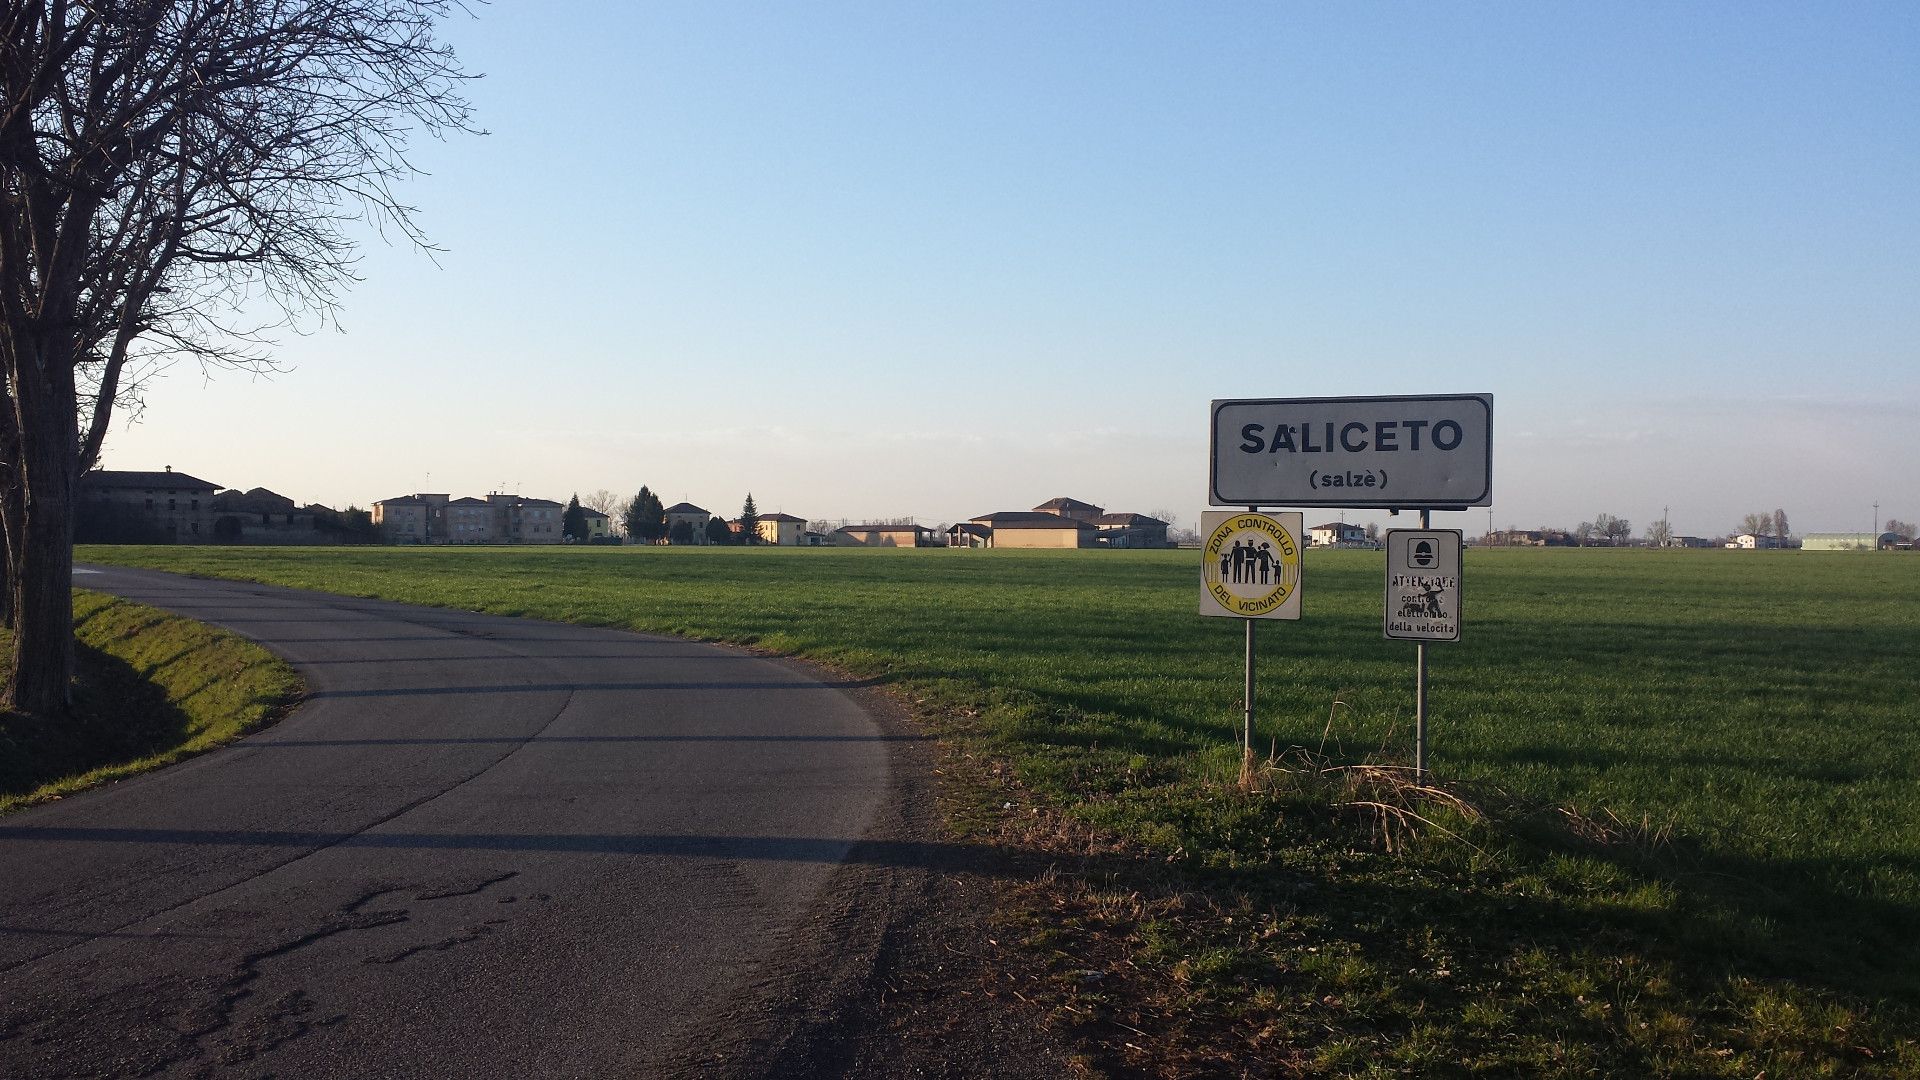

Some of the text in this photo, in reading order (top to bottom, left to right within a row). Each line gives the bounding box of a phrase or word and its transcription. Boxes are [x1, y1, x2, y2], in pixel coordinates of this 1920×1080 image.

[1239, 419, 1463, 454] SALICETO
[1309, 469, 1388, 490] (salzè)
[1209, 518, 1294, 556] ZONA CONTROLLO
[1214, 584, 1286, 612] DEL VICINATO
[1401, 593, 1443, 604] contro
[1389, 621, 1412, 632] della
